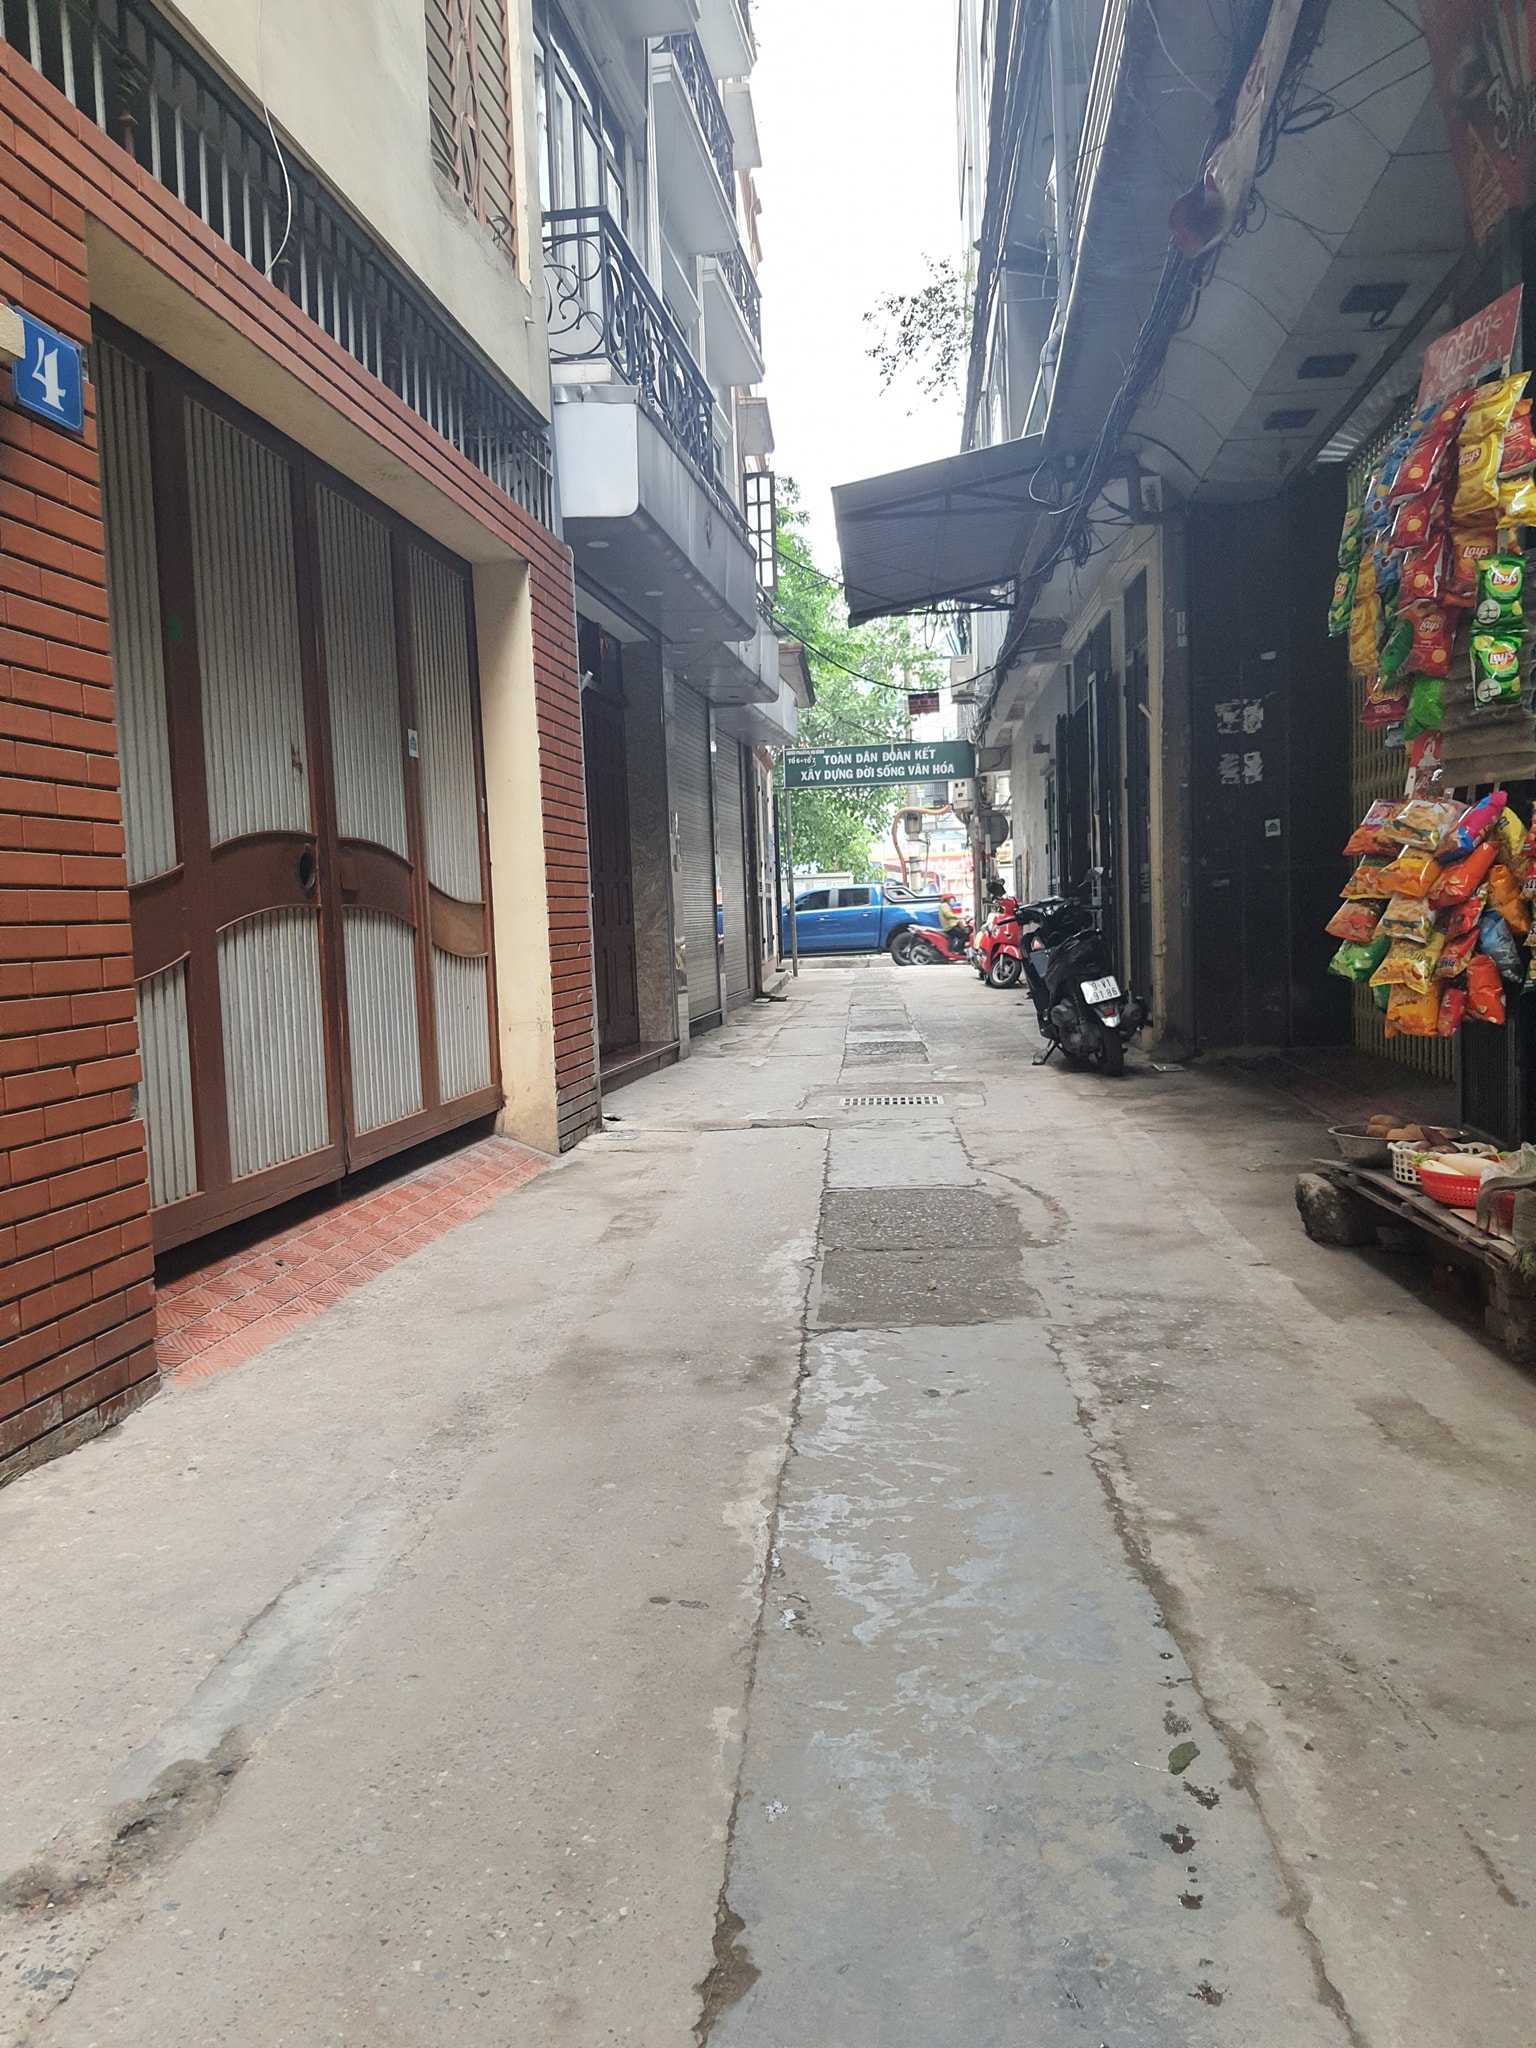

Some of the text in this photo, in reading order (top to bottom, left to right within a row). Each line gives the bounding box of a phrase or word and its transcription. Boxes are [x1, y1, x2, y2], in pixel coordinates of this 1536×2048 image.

[32, 337, 66, 411] 4
[824, 750, 852, 765] TOÀN
[856, 750, 878, 764] DÂN
[914, 746, 936, 760] KẾT
[801, 761, 955, 782] XÂY DỰNG ĐỜI SỐNG VĂN HÓA
